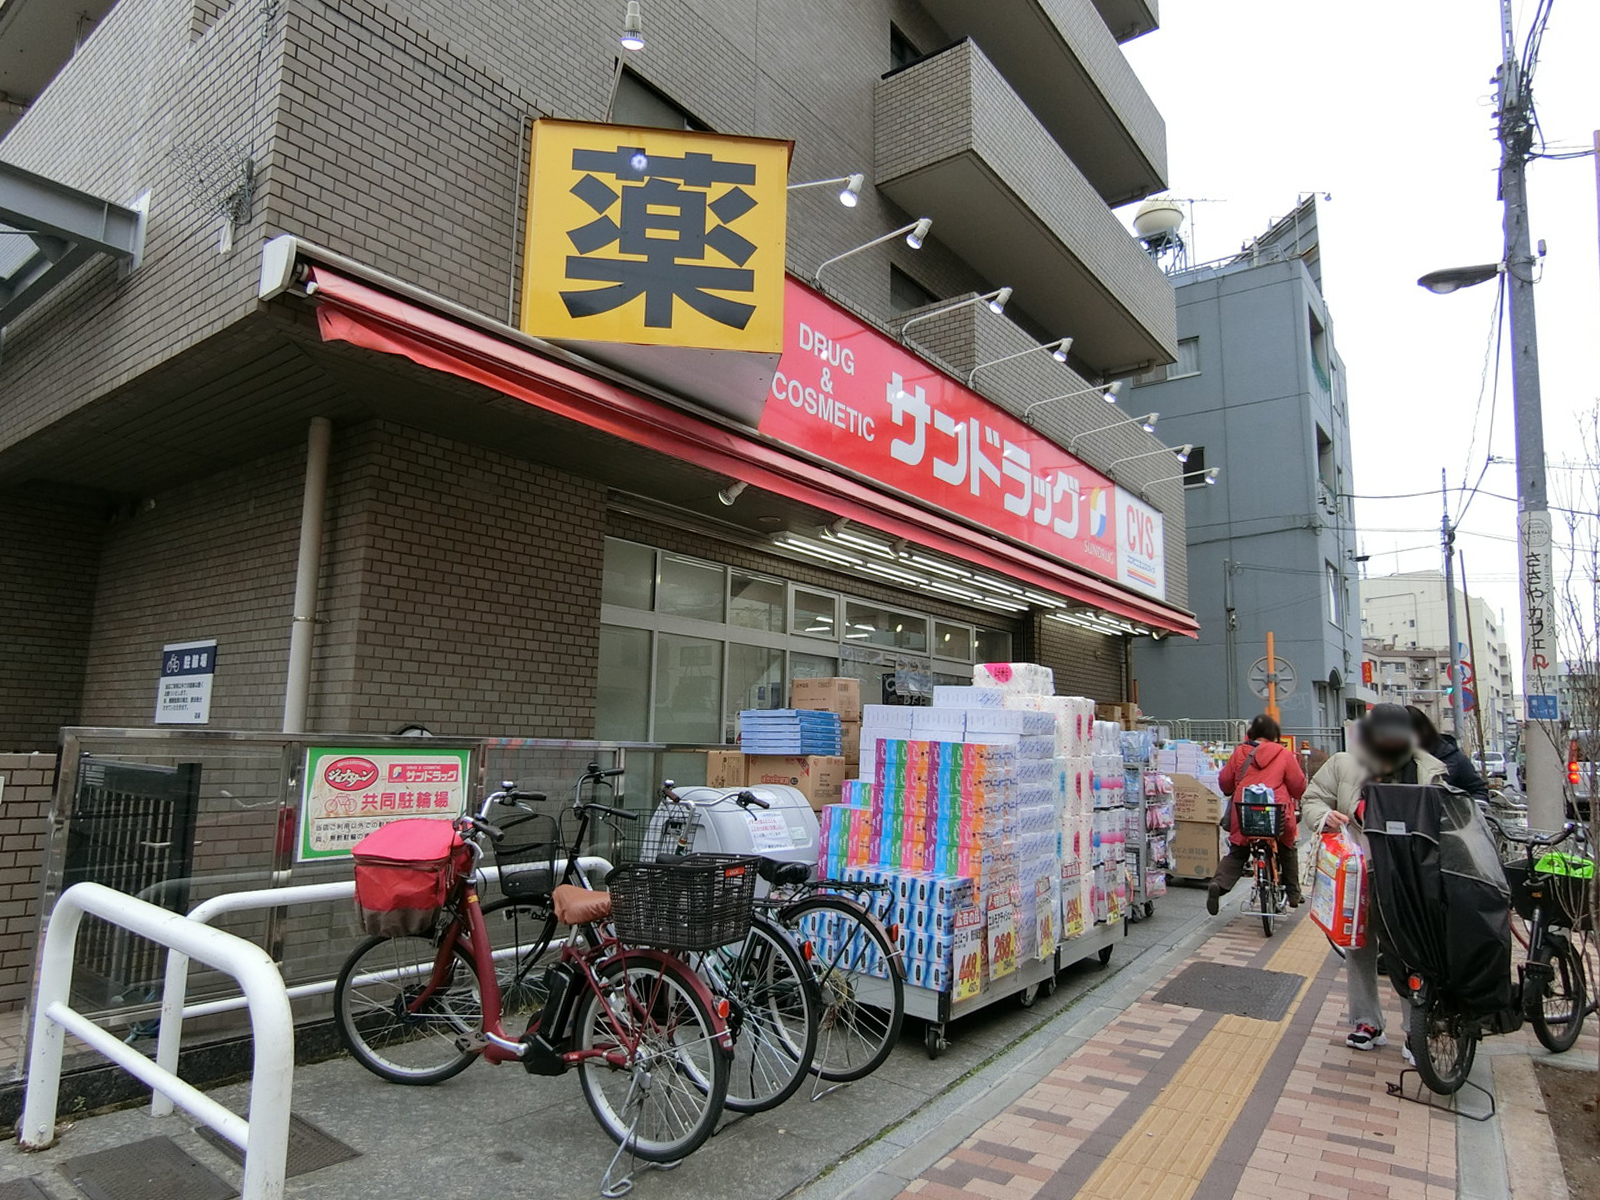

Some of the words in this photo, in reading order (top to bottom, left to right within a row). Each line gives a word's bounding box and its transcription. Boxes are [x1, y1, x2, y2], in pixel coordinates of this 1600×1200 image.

[558, 146, 759, 330] 薬
[799, 322, 855, 376] DRUG
[820, 366, 834, 395] &
[771, 371, 875, 441] COSMETIC
[886, 371, 1080, 540] サンドラッグ
[1126, 504, 1154, 560] CVS
[1084, 540, 1114, 565] SUNDRUG
[406, 770, 457, 782] サンドラッグ
[360, 791, 449, 811] 共同駐輪場
[993, 930, 1011, 964] 268
[959, 951, 977, 985] 448
